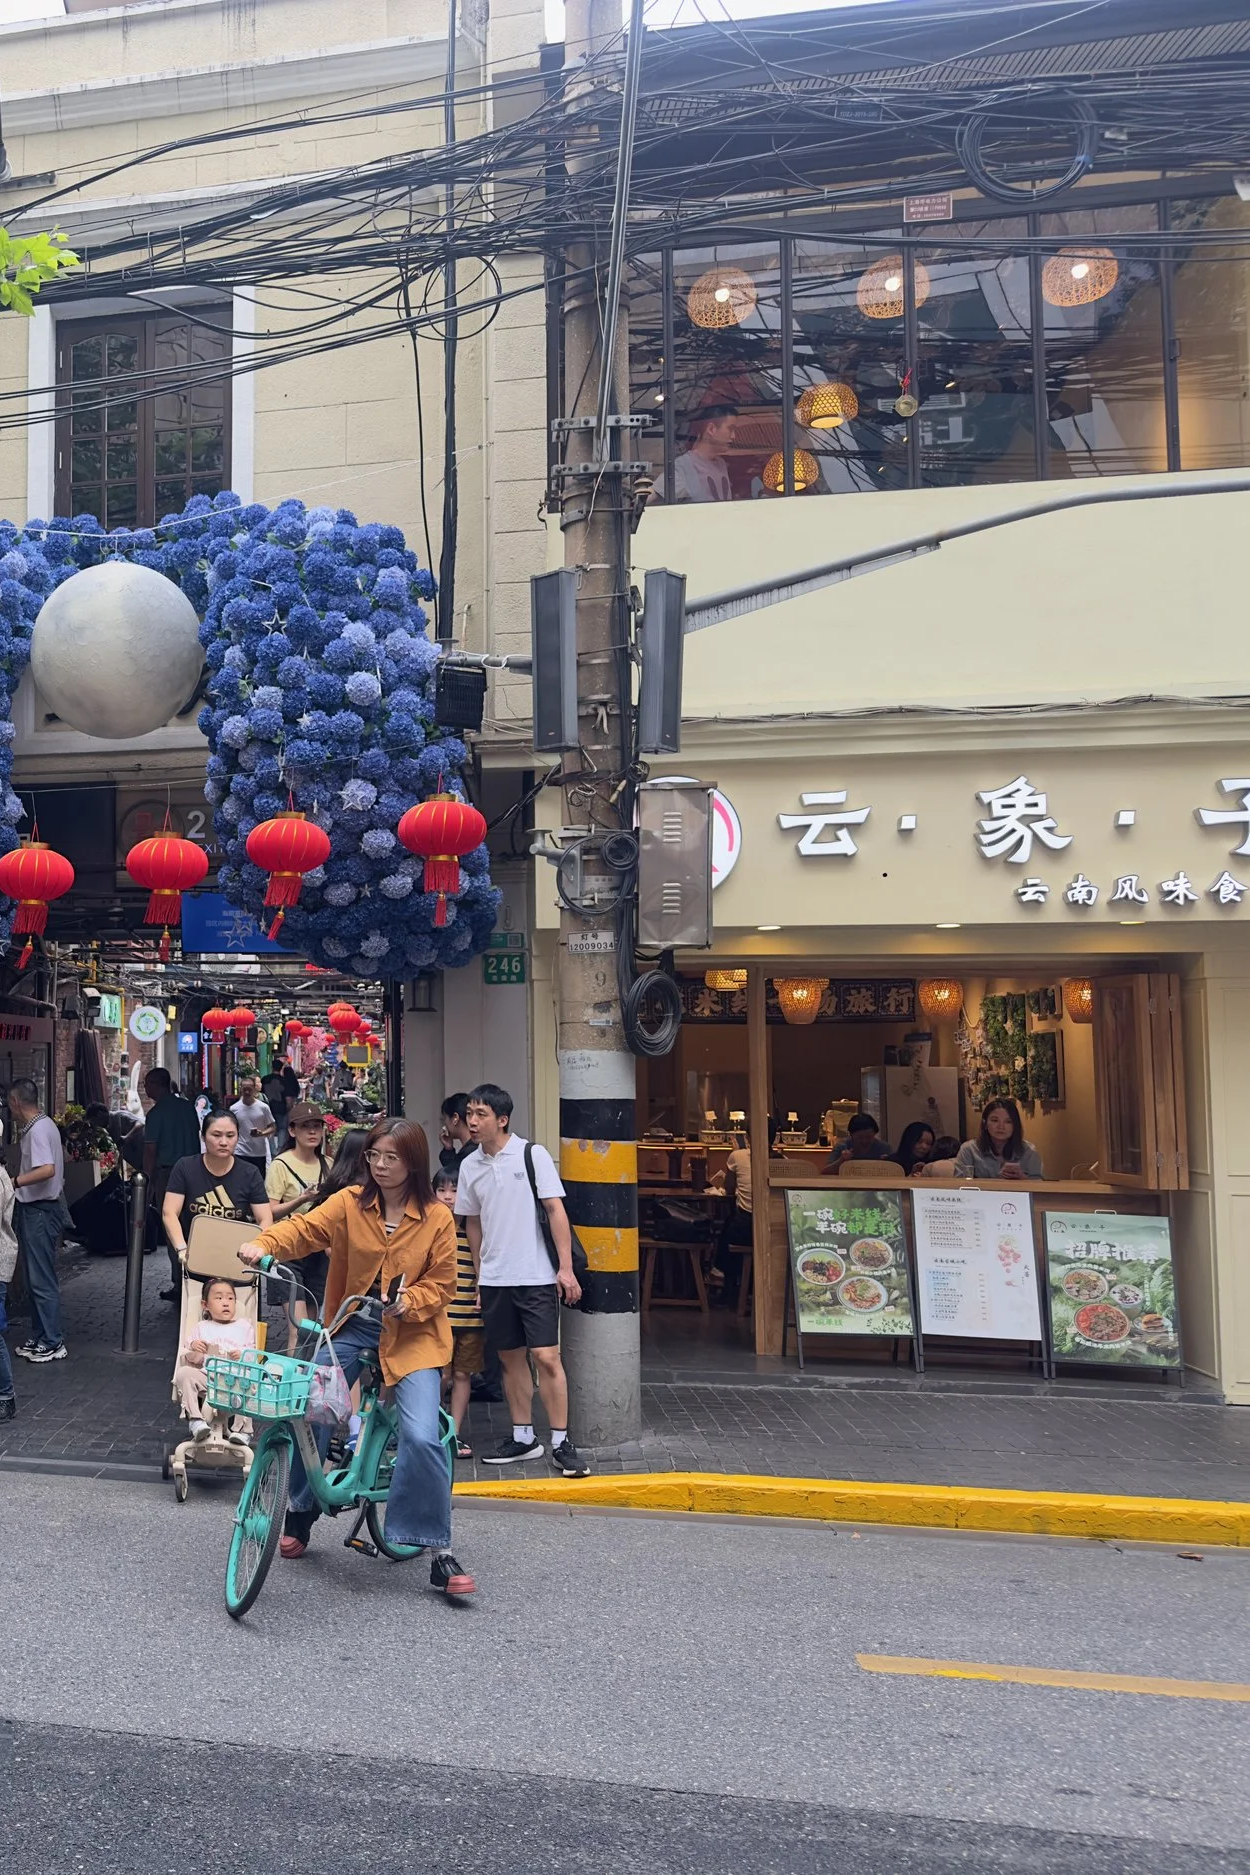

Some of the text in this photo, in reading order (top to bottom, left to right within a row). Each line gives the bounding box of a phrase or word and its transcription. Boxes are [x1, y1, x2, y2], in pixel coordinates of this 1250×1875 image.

[186, 810, 206, 839] 2
[1016, 870, 1250, 908] 云南风味食
[569, 942, 614, 952] 12009034
[487, 957, 521, 974] 246
[189, 1202, 243, 1220] adidas
[1065, 1240, 1160, 1265] 招牌推荐
